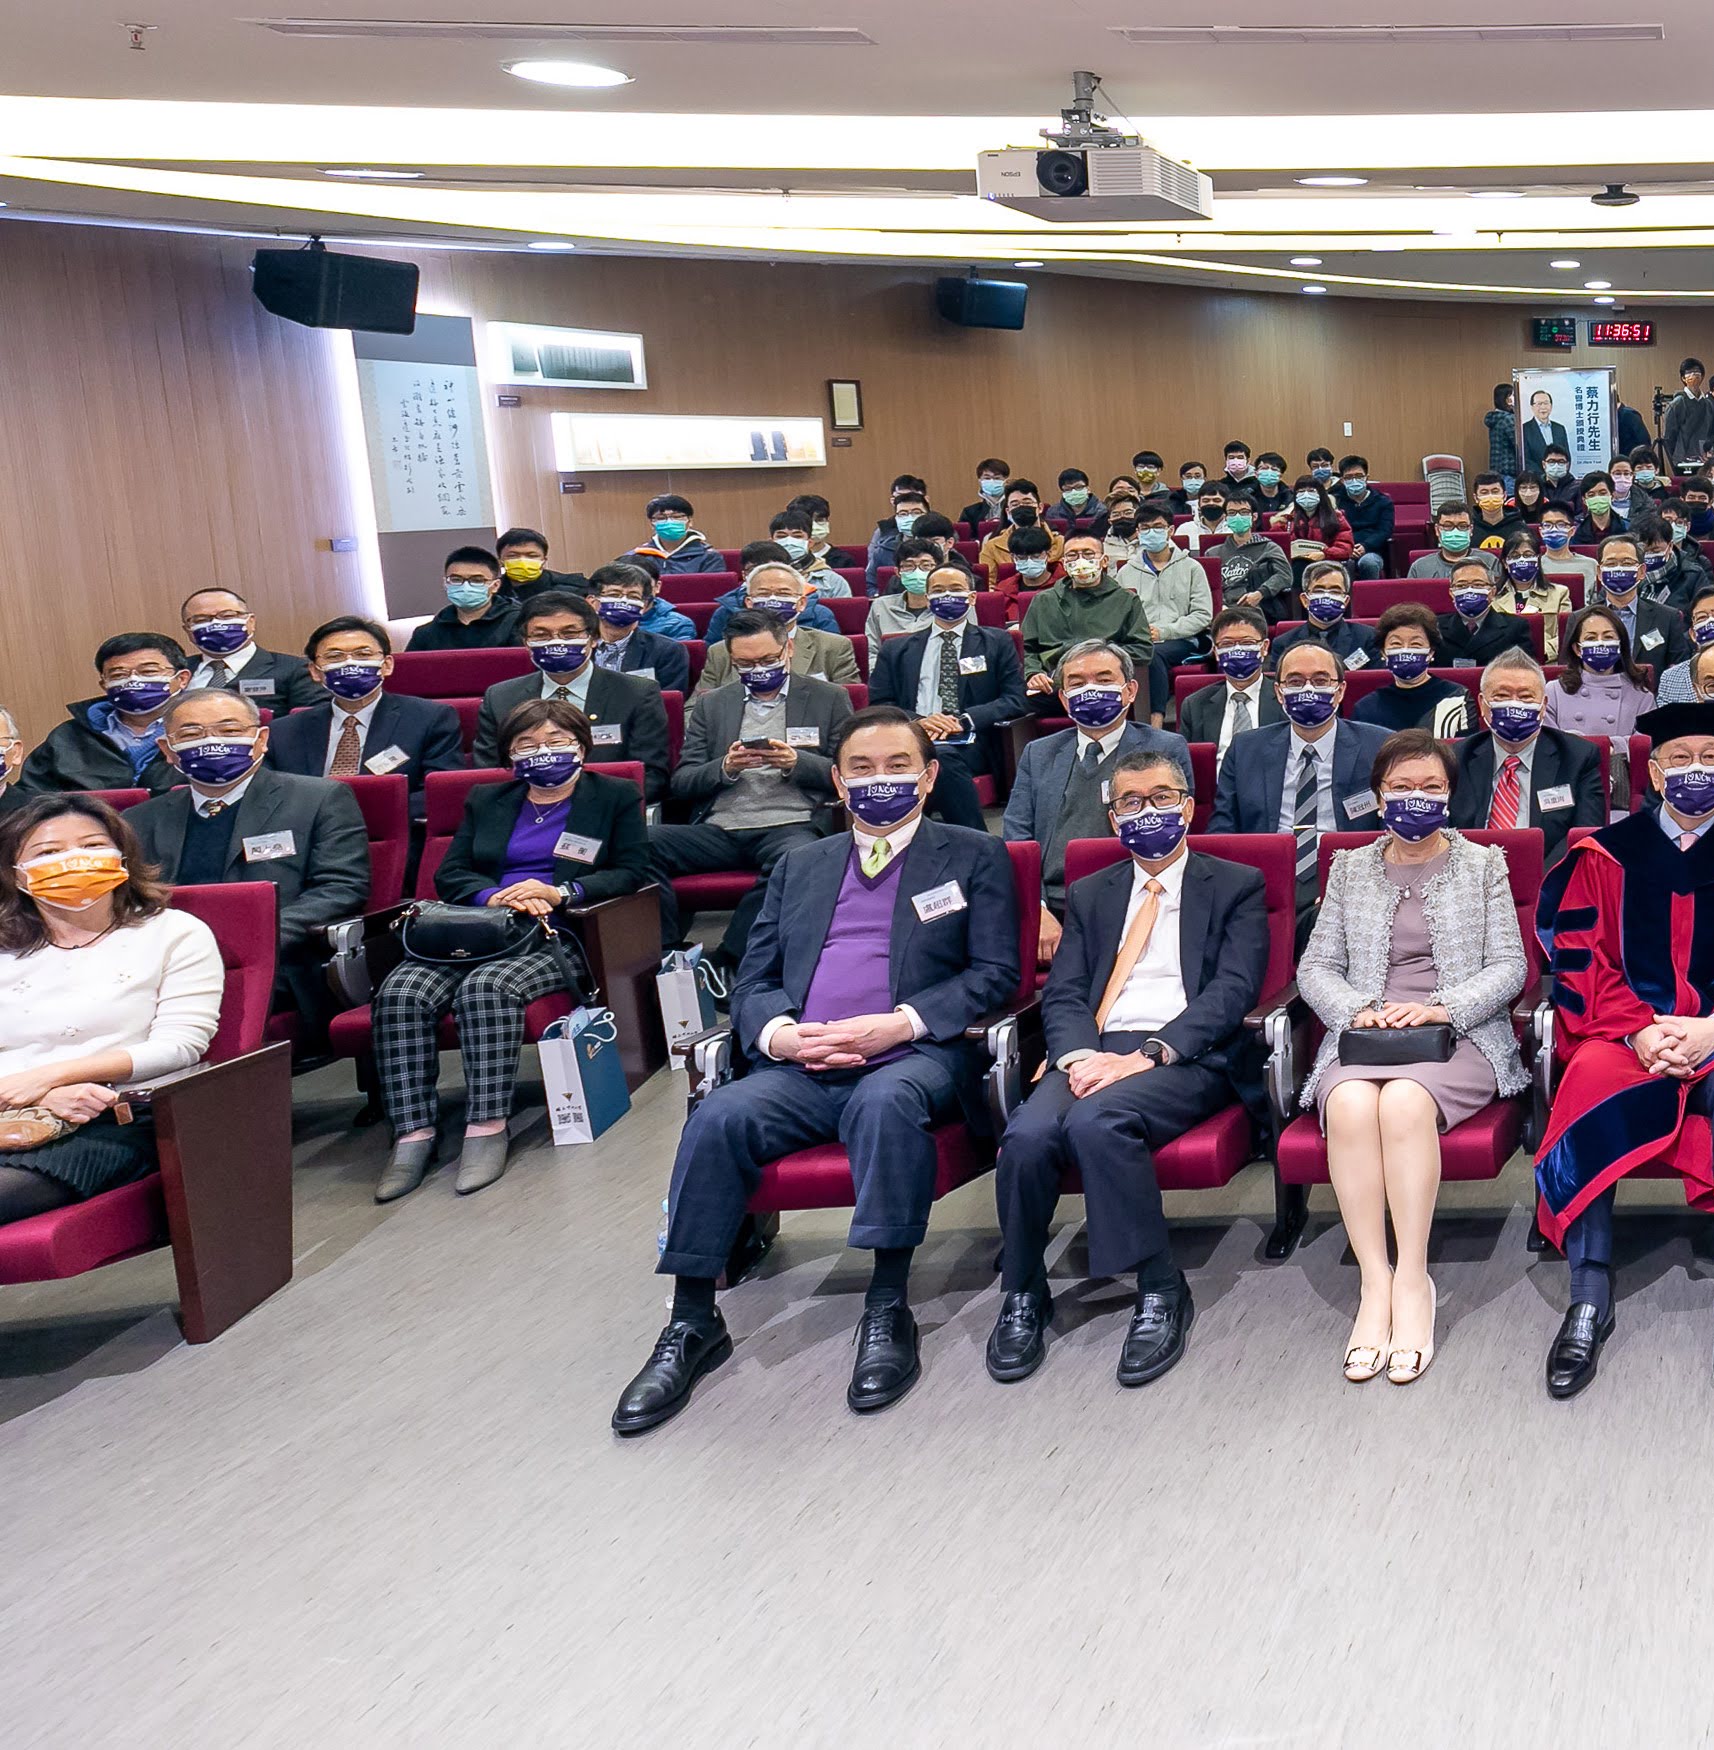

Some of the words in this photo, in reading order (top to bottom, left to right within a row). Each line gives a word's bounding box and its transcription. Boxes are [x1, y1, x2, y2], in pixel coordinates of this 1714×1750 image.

[1595, 324, 1650, 337] 11:36:51
[1575, 386, 1585, 451] 名譽博士頒授典禮
[1586, 386, 1601, 451] 蔡力行先生
